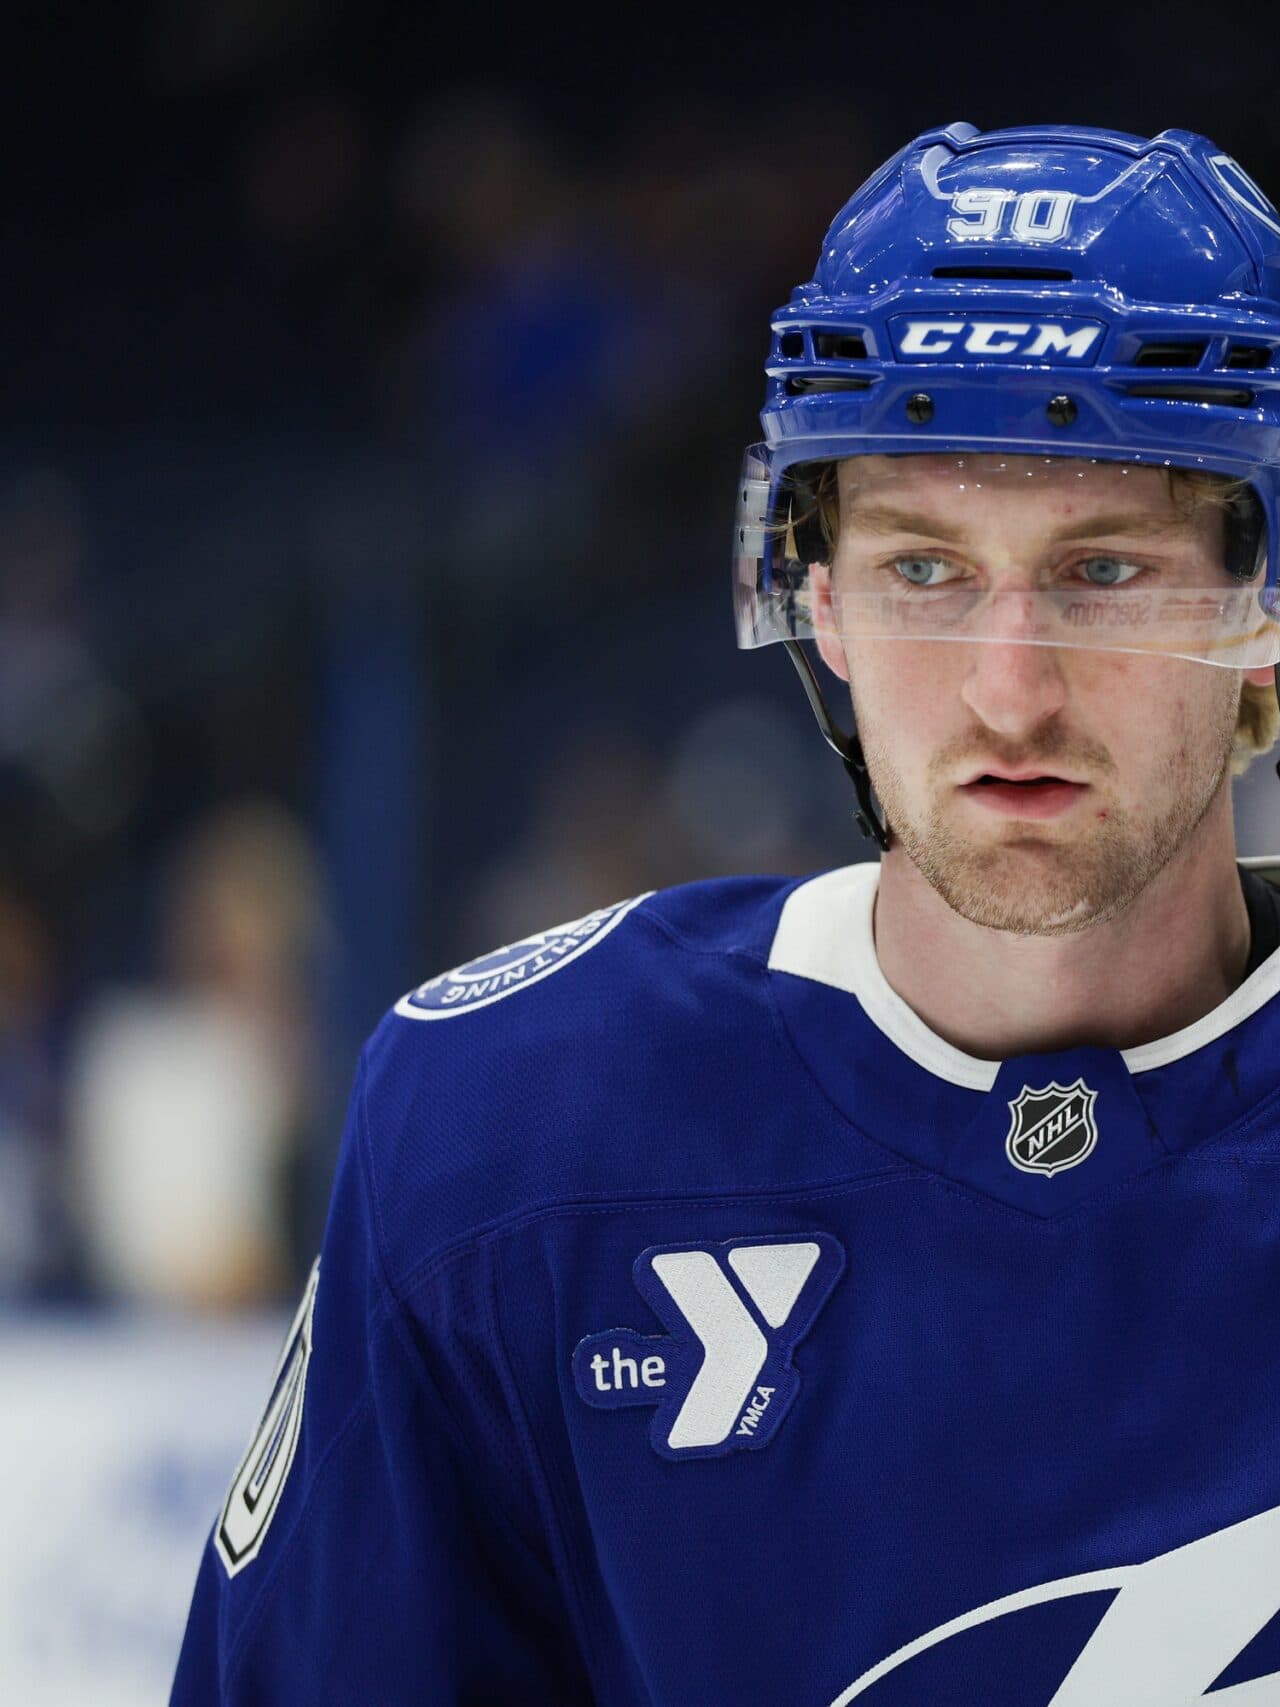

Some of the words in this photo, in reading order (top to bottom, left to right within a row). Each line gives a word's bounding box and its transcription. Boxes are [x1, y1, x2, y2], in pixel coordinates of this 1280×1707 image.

[945, 187, 1080, 241] 90
[900, 322, 1100, 359] CCM
[1028, 1104, 1079, 1158] NHL
[590, 1347, 666, 1391] the
[213, 1256, 321, 1579] 0
[736, 1385, 776, 1437] YMCA
